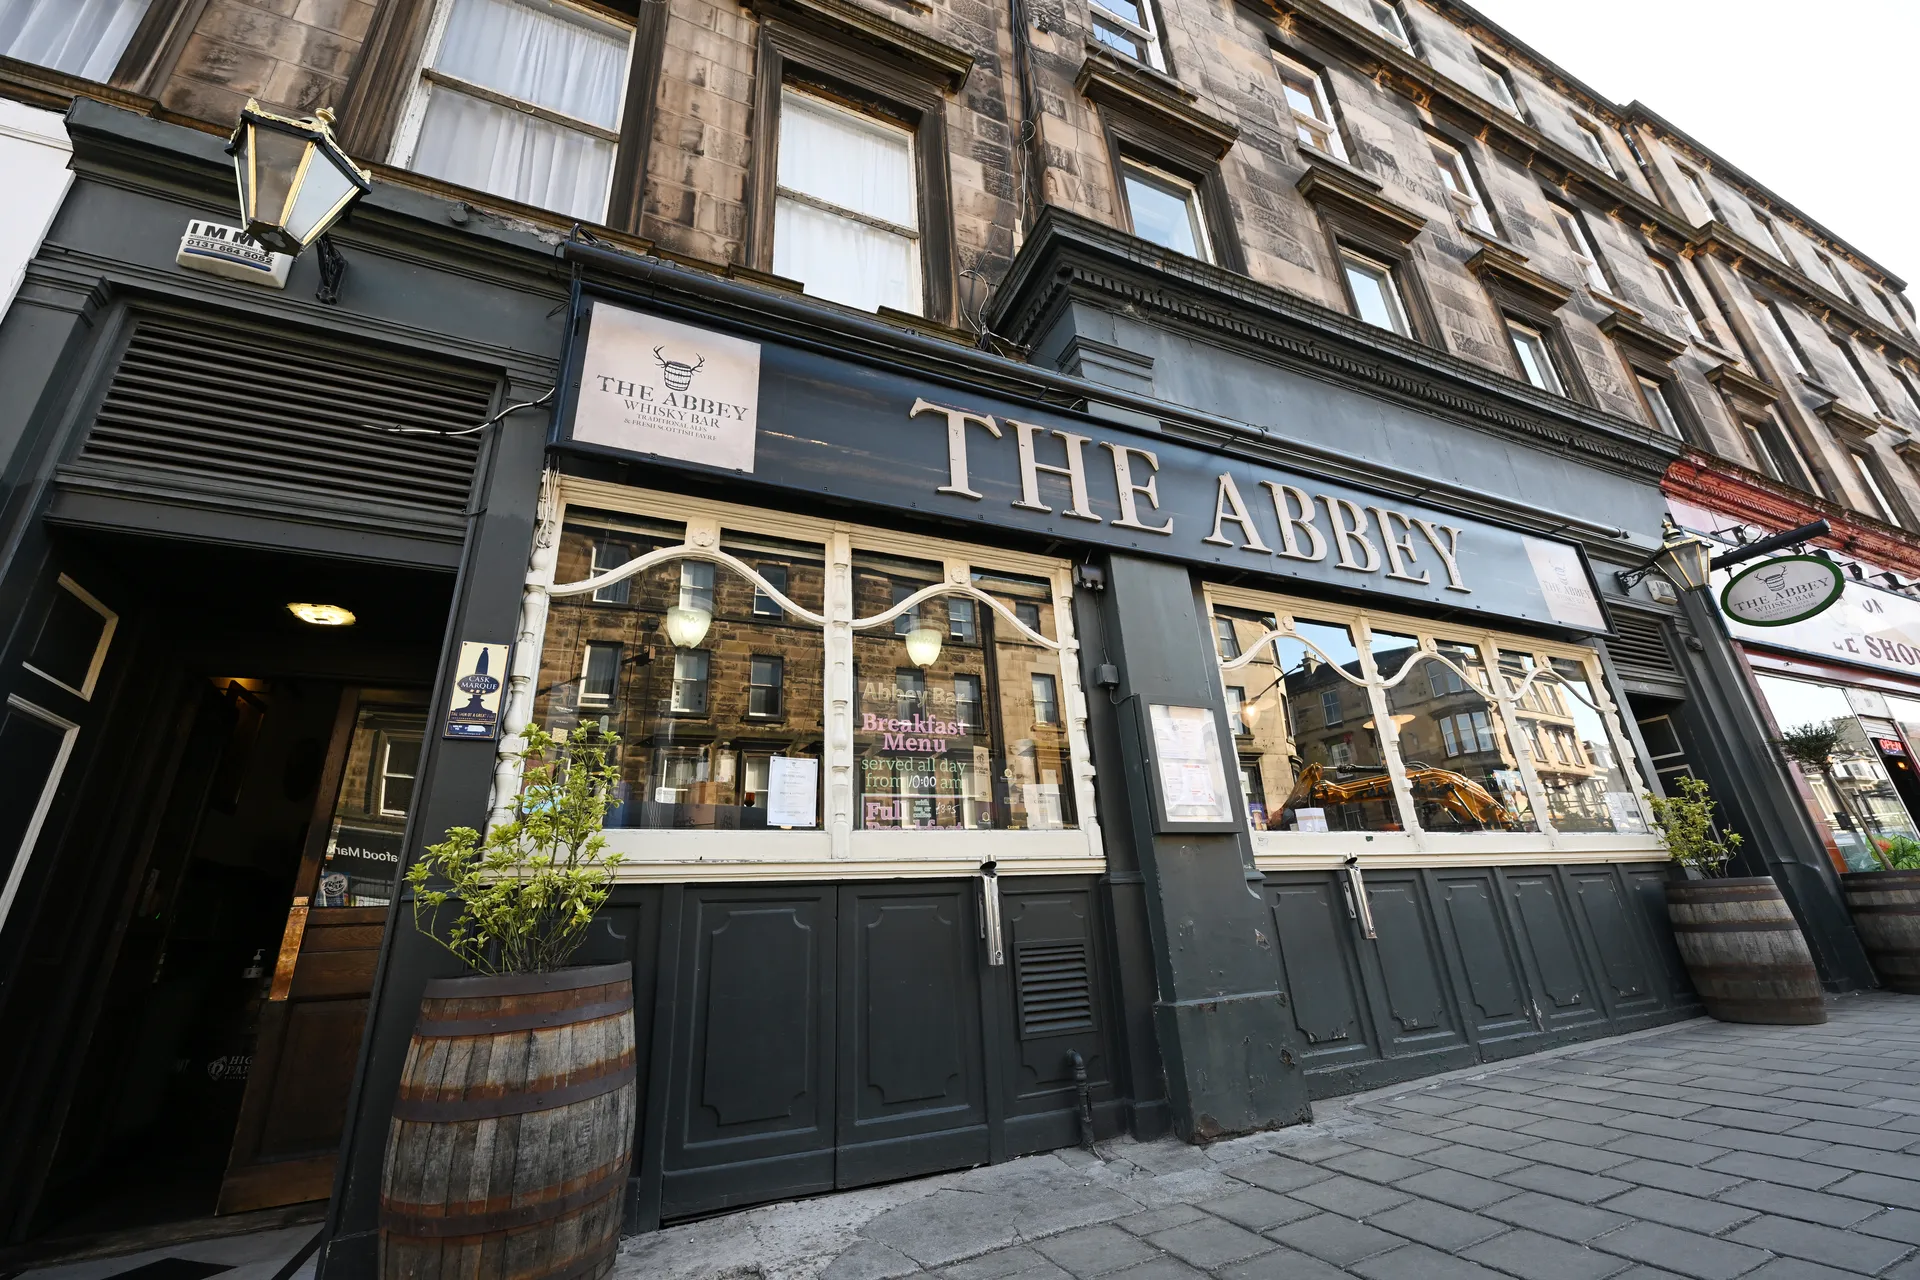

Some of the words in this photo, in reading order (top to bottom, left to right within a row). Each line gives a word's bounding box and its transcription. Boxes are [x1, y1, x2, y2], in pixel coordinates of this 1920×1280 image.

[187, 240, 215, 249] 0131
[597, 374, 654, 402] THE
[663, 392, 749, 421] ABBEY
[624, 399, 687, 421] WHISKY
[691, 414, 720, 428] BAR
[637, 414, 689, 429] TRADITIONAL
[632, 420, 656, 429] FRESH
[658, 425, 694, 437] SCOTTISH
[695, 433, 717, 441] FAYRE
[910, 397, 1174, 536] THE
[1202, 471, 1472, 594] ABBEY
[1734, 595, 1770, 611] THE
[1775, 577, 1829, 600] ABBEY
[1754, 597, 1794, 613] WHISKY
[1795, 592, 1816, 602] BAR
[461, 682, 497, 690] MARQUE
[469, 676, 490, 684] CASK
[862, 682, 928, 708] Abbey
[933, 688, 965, 705] Bar
[862, 713, 966, 736] Breakfast
[882, 733, 947, 753] Menu
[1880, 739, 1902, 750] OPEN
[862, 757, 914, 771] served
[918, 758, 935, 772] all
[940, 759, 966, 776] day
[866, 773, 903, 788] from
[940, 777, 964, 789] am
[866, 800, 909, 820] Full
[230, 1056, 252, 1064] HIG
